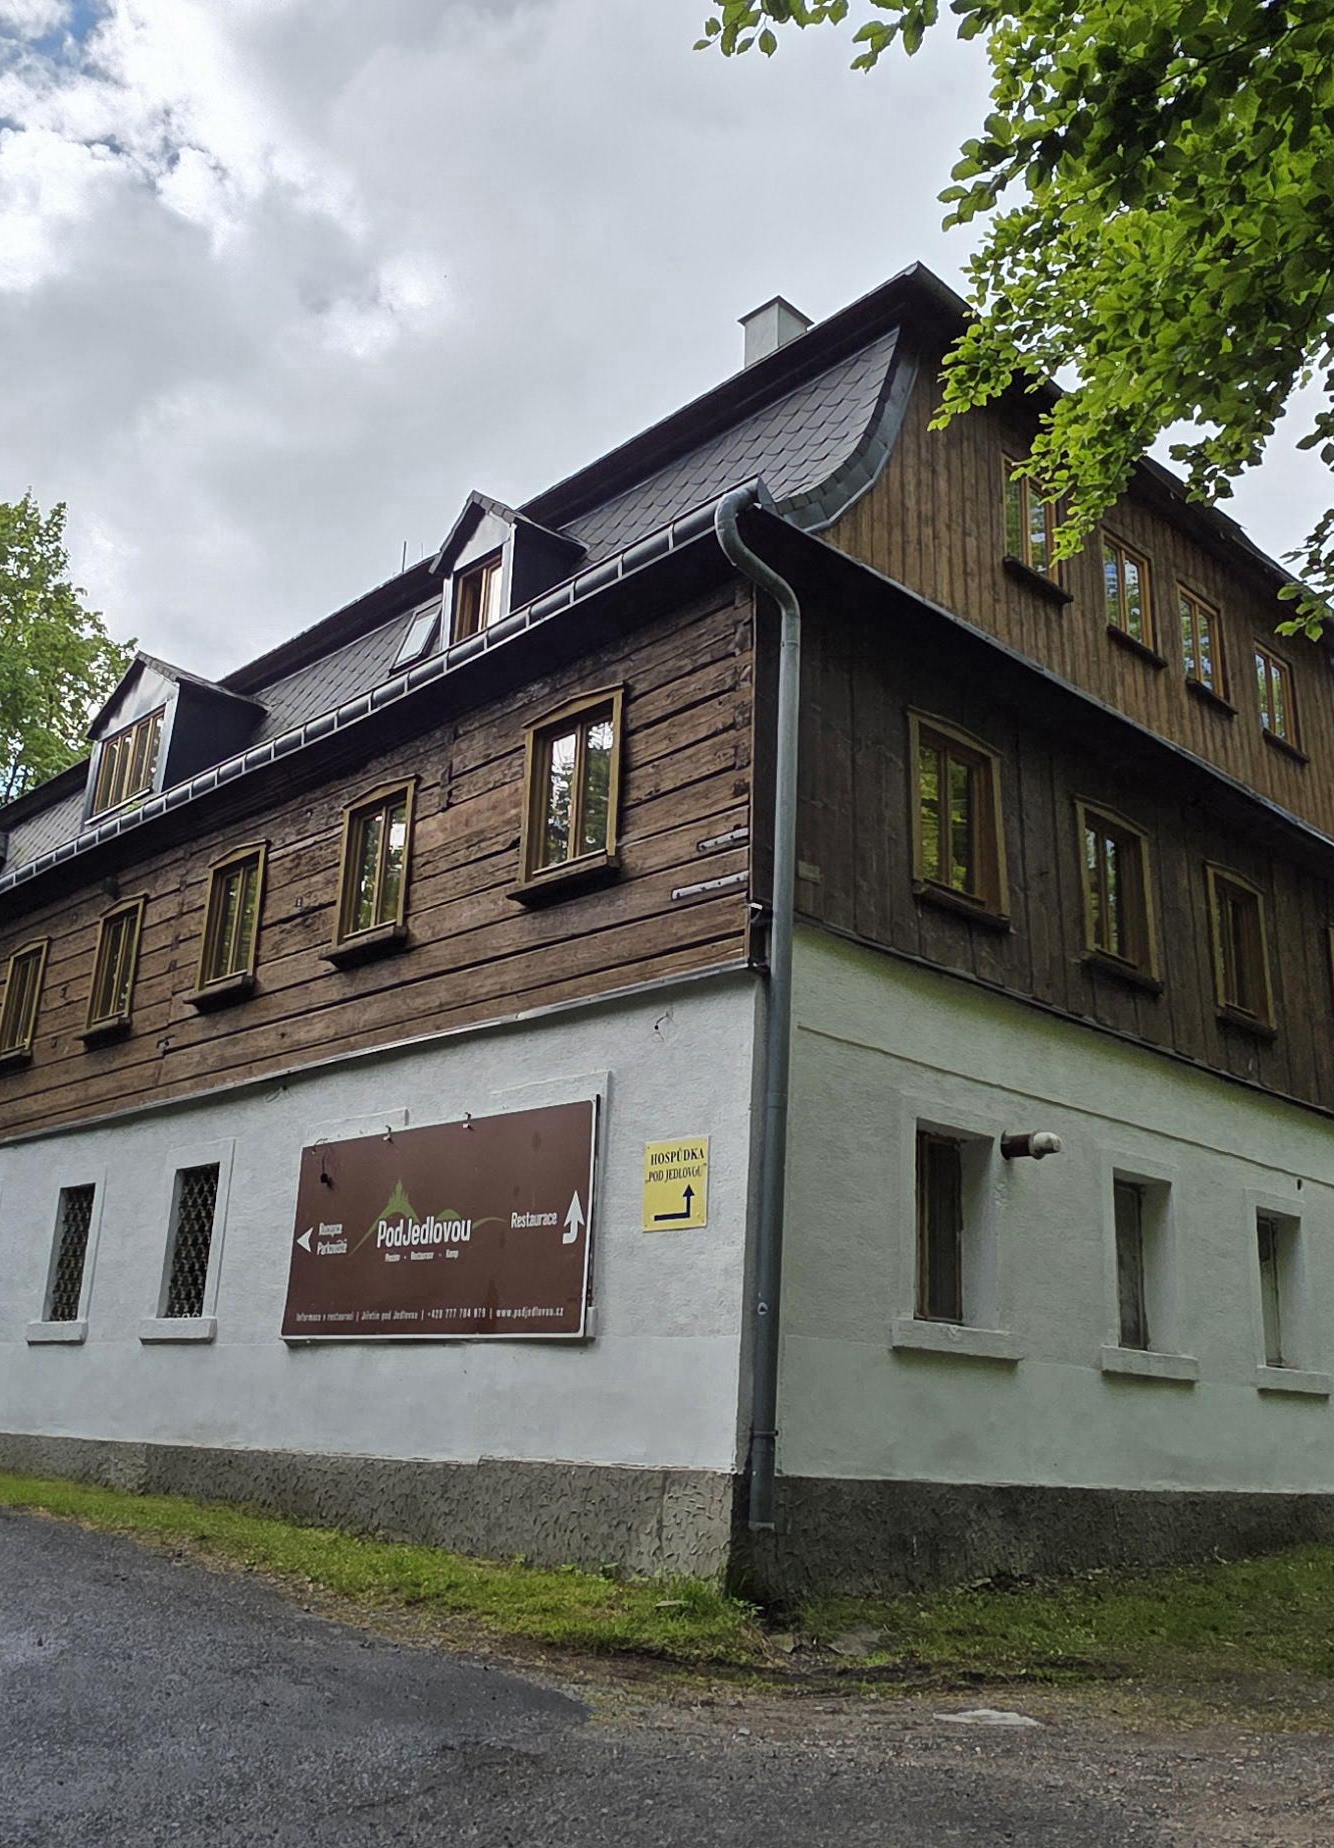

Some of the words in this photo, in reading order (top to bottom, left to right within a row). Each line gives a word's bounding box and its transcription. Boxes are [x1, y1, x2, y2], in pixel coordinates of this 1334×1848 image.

[650, 1147, 704, 1166] HOSPŮDKA
[511, 1211, 557, 1229] Restaurace
[376, 1215, 472, 1249] PodJedlovou
